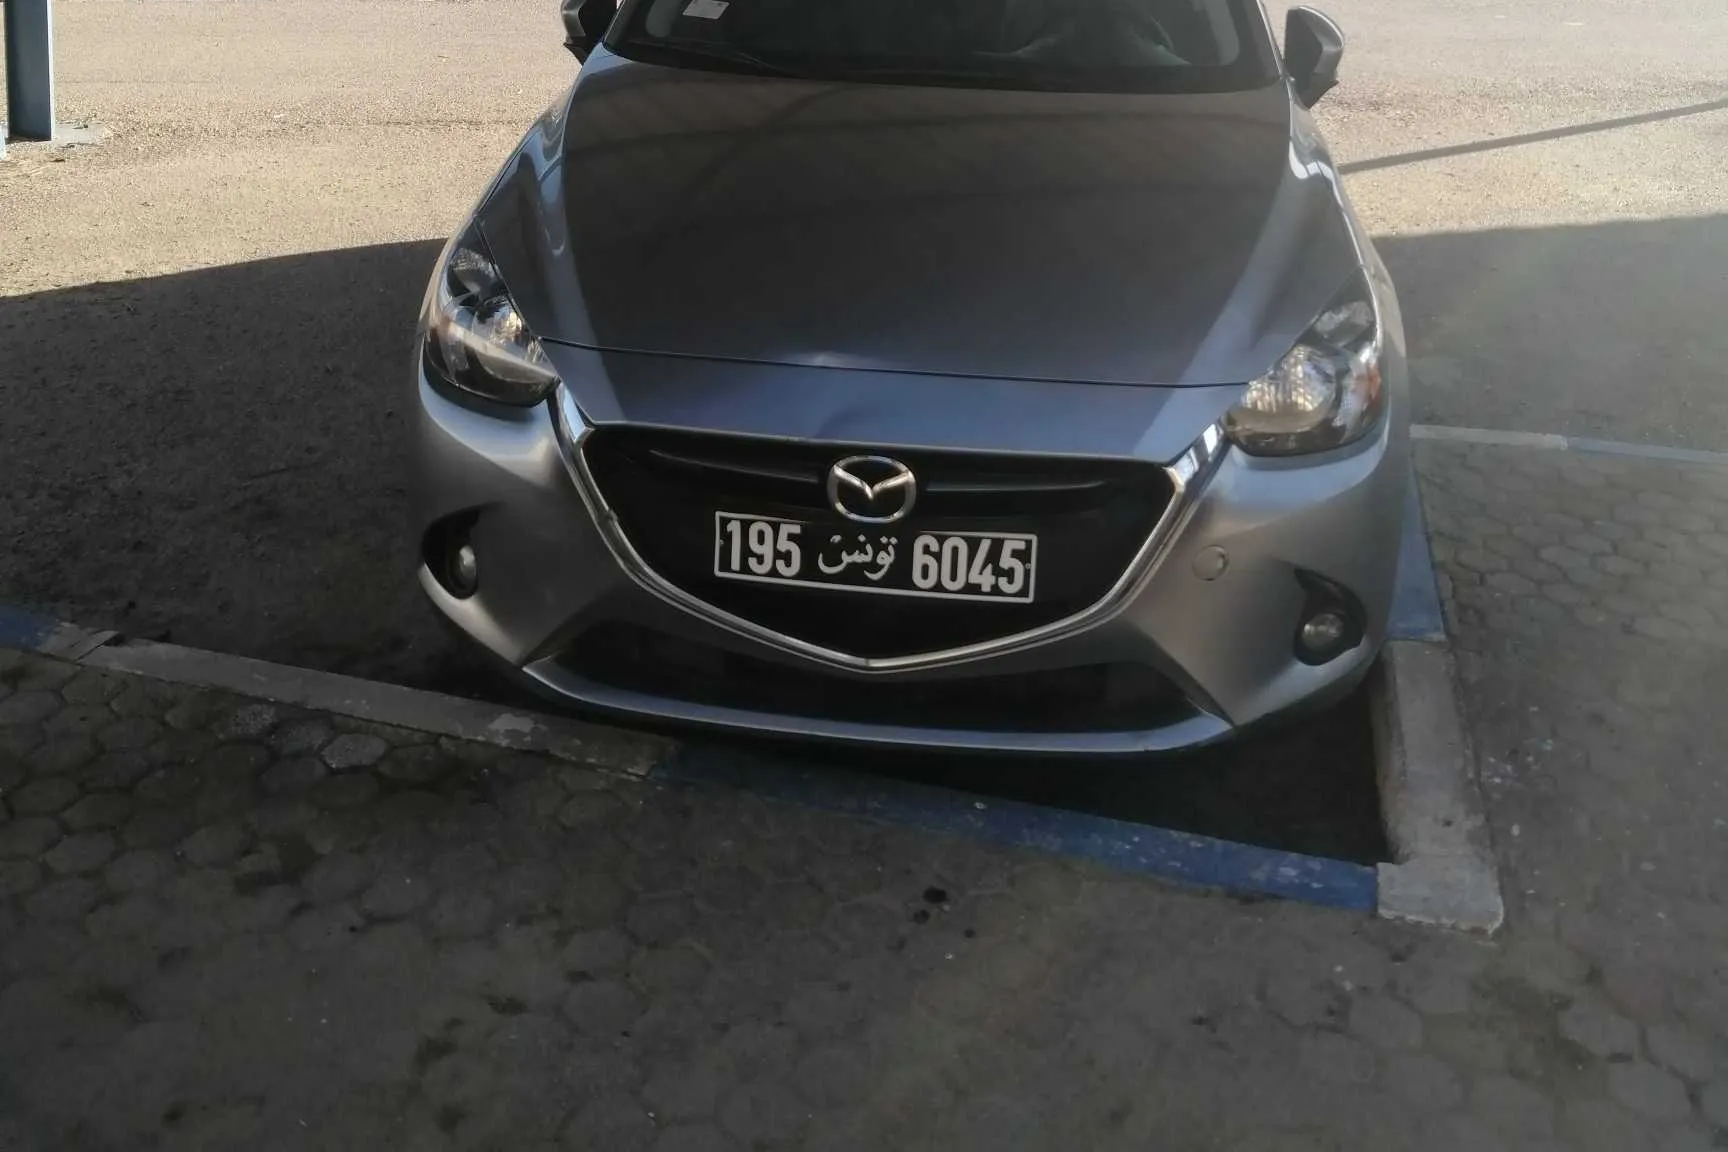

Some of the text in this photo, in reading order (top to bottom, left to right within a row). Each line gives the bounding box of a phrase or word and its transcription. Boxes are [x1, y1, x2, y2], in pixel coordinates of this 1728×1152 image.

[726, 520, 1027, 594] 195 تونس 6045
